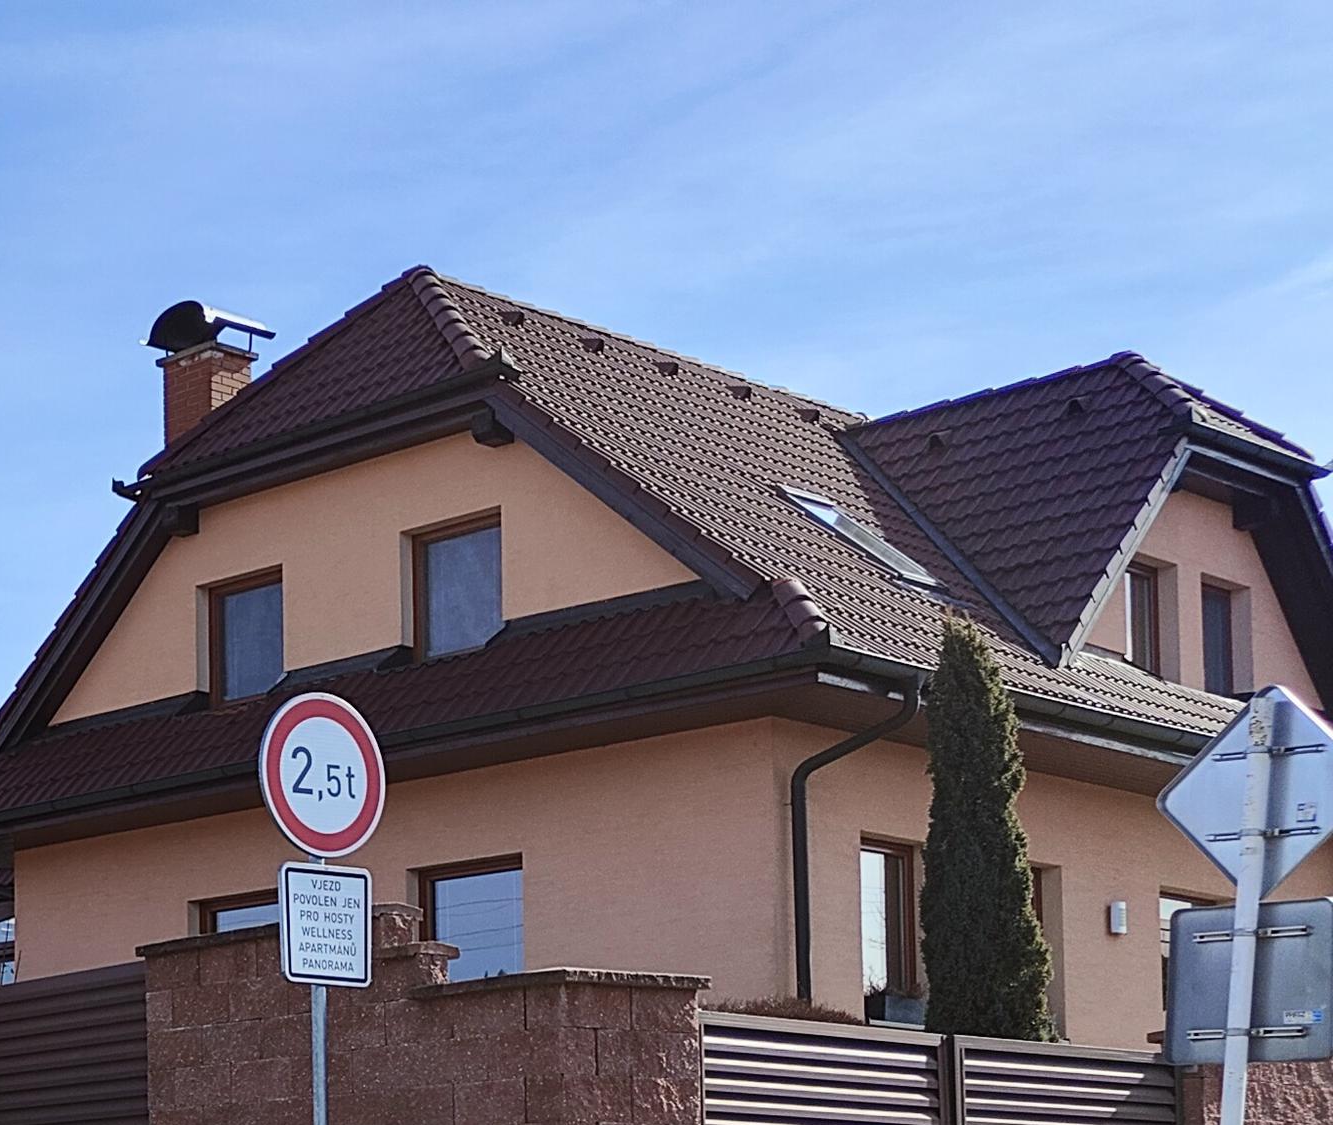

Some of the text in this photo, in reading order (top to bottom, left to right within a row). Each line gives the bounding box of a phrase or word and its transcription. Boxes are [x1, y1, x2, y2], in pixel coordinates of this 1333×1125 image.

[311, 879, 342, 892] VJEZD
[293, 893, 361, 909] POVOLEN JEN
[300, 909, 355, 925] PRO HOSTY
[302, 926, 353, 941] WELLNESS
[302, 957, 355, 973] PANORAMA
